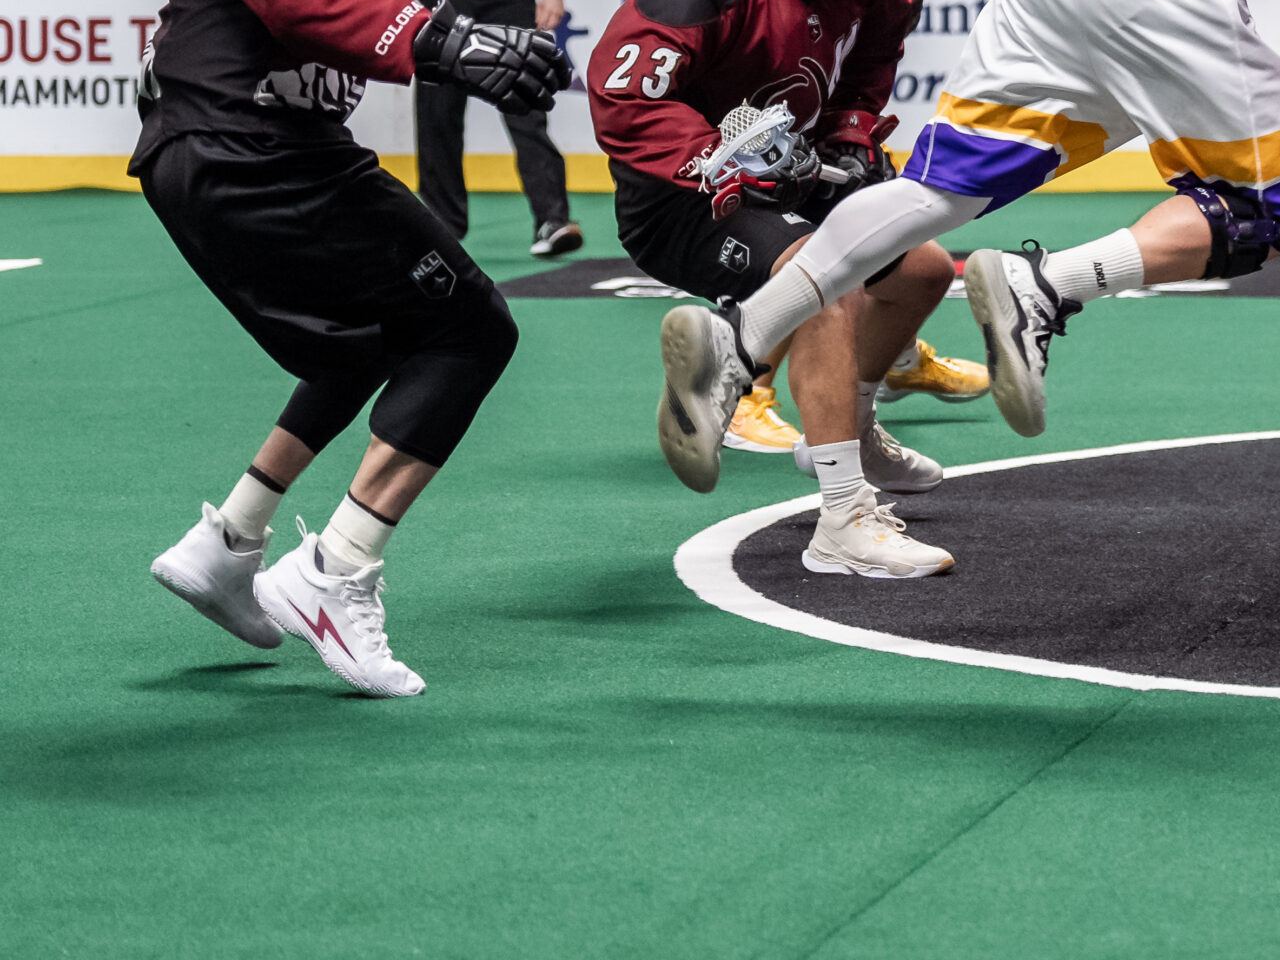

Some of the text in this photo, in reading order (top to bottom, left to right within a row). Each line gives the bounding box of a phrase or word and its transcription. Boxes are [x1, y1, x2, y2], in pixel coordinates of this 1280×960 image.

[604, 44, 681, 98] 23
[0, 78, 138, 106] AMMOT
[720, 241, 734, 264] NLL
[412, 257, 439, 280] NLL
